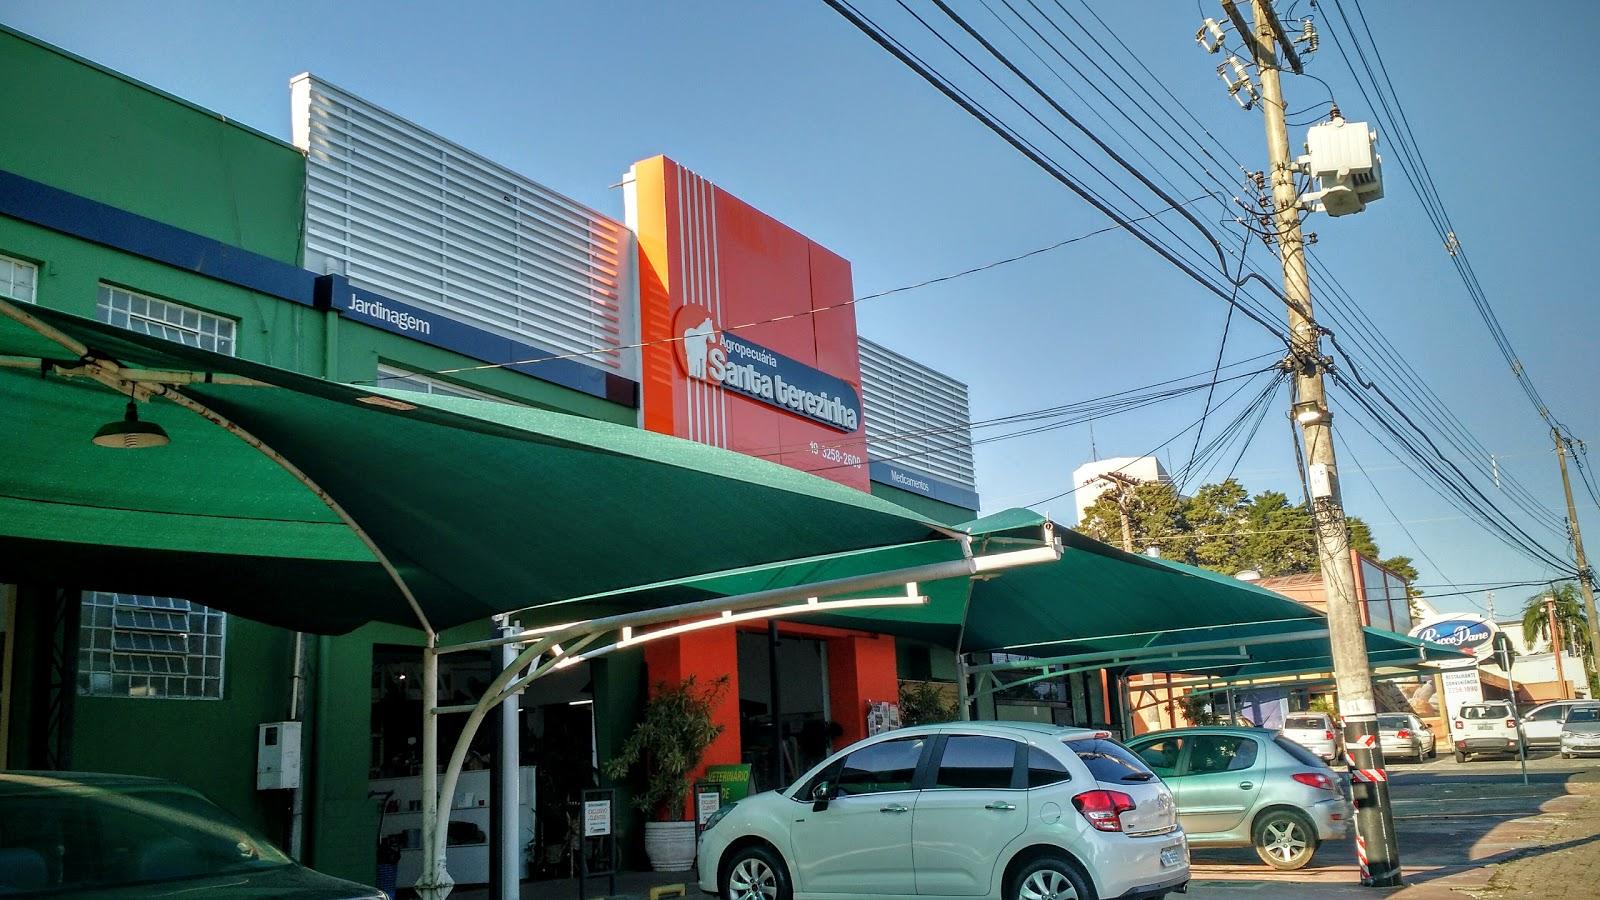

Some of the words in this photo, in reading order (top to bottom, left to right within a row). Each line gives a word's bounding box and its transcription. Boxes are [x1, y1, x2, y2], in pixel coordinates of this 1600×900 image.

[348, 293, 431, 335] Jardinagem
[719, 334, 777, 368] Agropecuária
[709, 348, 774, 399] Santa
[774, 374, 858, 431] terezinha
[890, 470, 929, 492] Medicamentos
[1454, 625, 1489, 646] Pane
